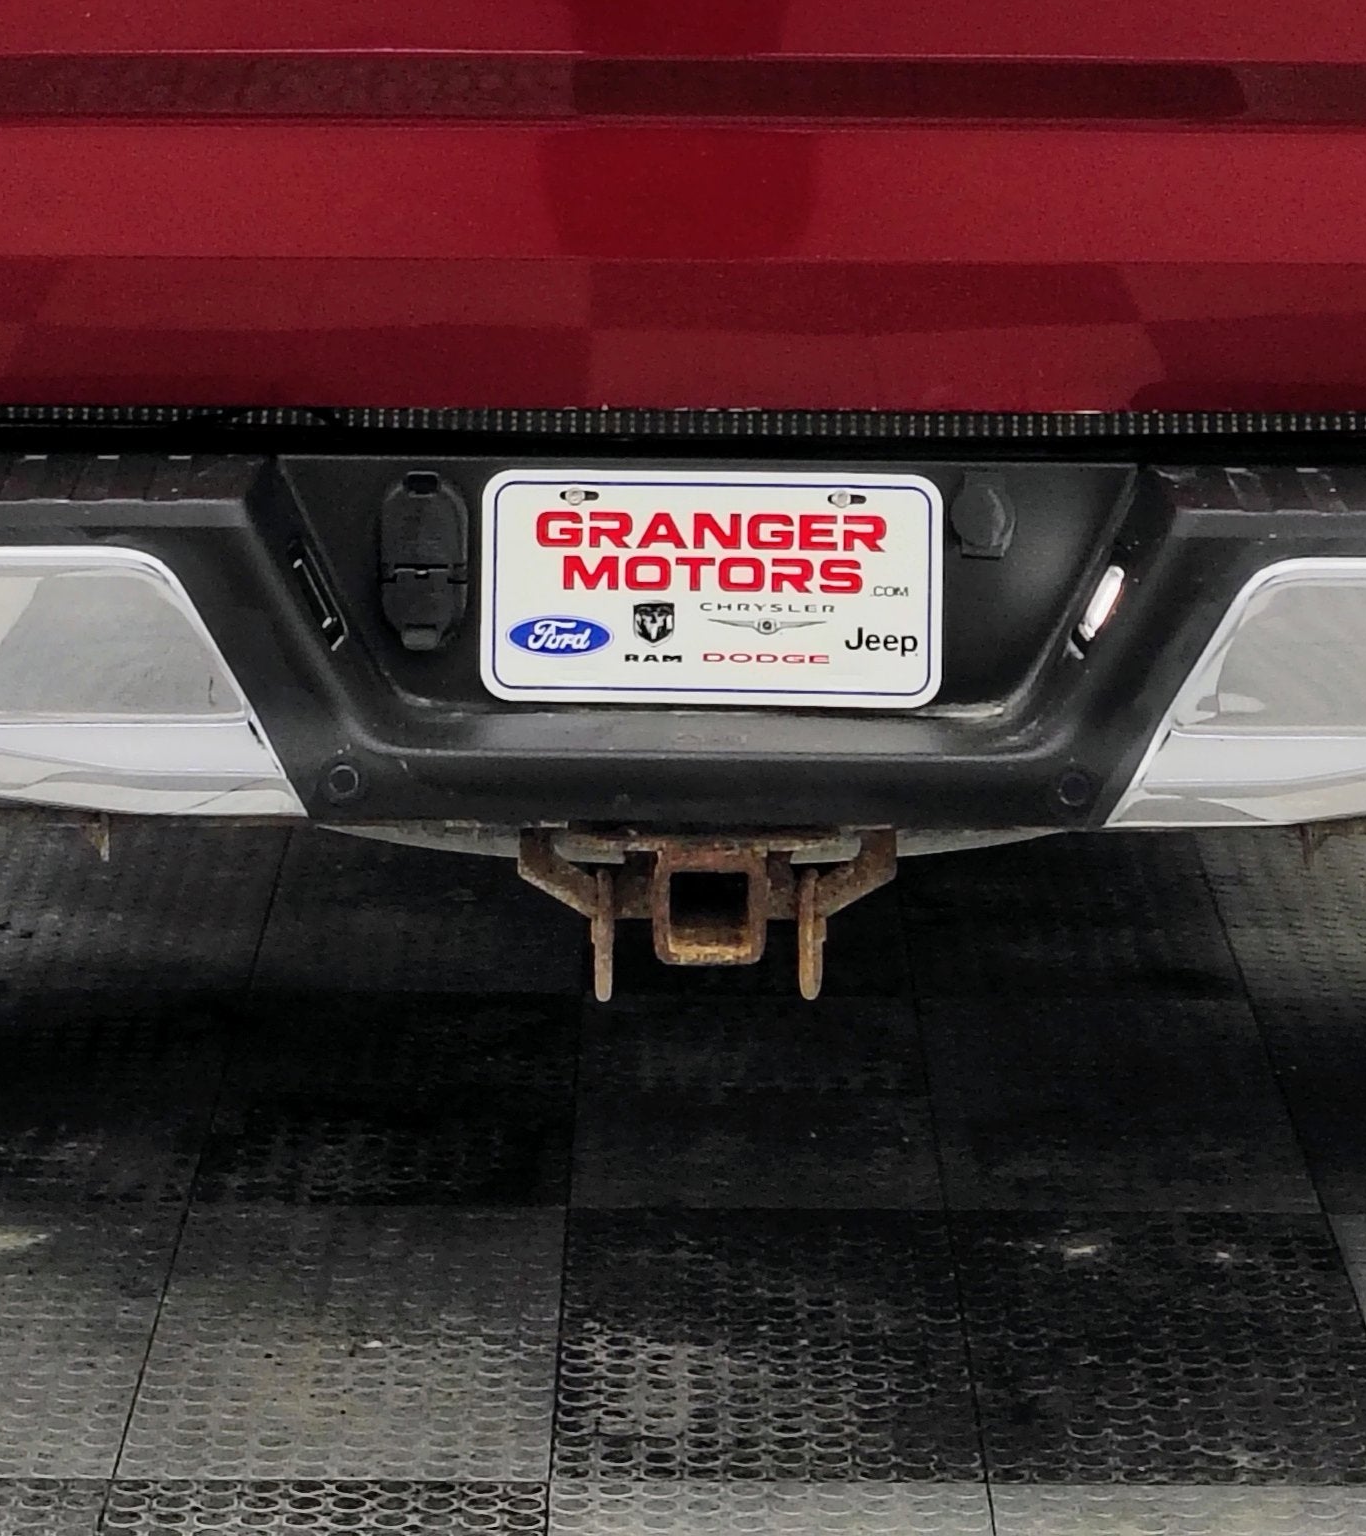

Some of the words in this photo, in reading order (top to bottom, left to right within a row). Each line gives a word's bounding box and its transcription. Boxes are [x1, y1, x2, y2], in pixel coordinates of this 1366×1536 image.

[535, 510, 887, 553] GRANGER
[562, 554, 863, 594] MOTORS
[699, 602, 836, 613] CHRYSLER
[528, 620, 591, 651] Ford
[844, 627, 919, 657] Jeep
[624, 653, 683, 664] RAM
[702, 653, 830, 665] DODGE
